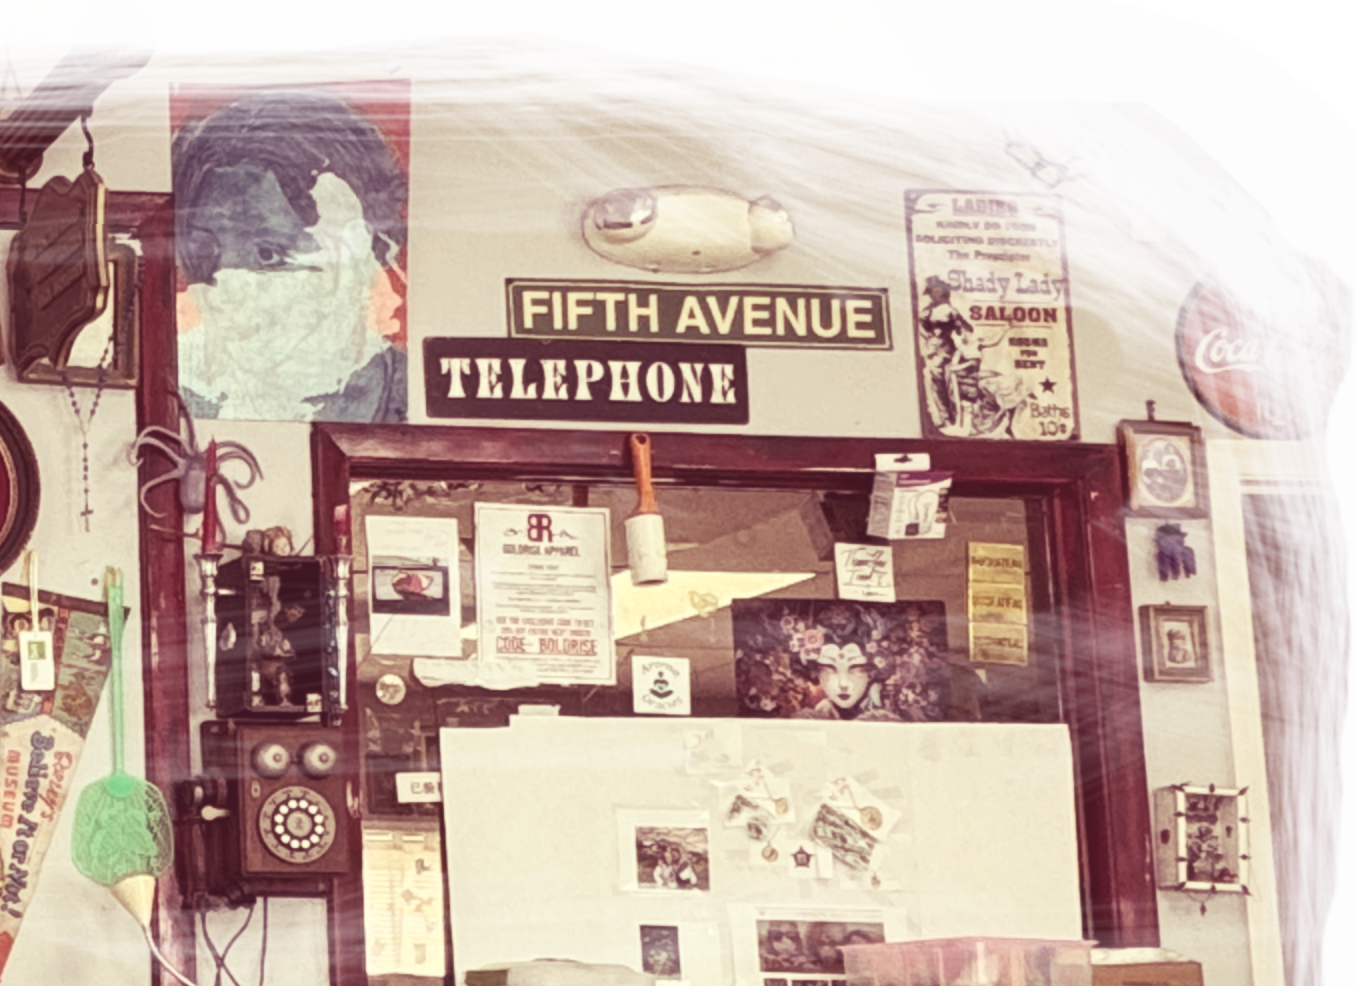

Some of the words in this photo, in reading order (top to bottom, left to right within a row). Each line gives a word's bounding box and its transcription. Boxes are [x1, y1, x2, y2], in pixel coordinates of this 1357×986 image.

[951, 198, 1018, 217] LADIES
[936, 221, 980, 230] KINDLY
[984, 222, 1001, 230] DO
[1005, 222, 1037, 232] YOUR
[915, 234, 984, 244] SOLICITING
[947, 250, 970, 260] The
[948, 269, 1011, 300] Shady
[1014, 271, 1065, 301] Lady
[521, 291, 660, 333] FIFTH
[675, 295, 877, 339] AVENUE
[969, 305, 1058, 323] SALOON
[439, 358, 737, 404] TELEPHONE
[1030, 402, 1071, 419] Baths
[20, 731, 55, 814] Believe
[0, 749, 22, 830] MUSEUM
